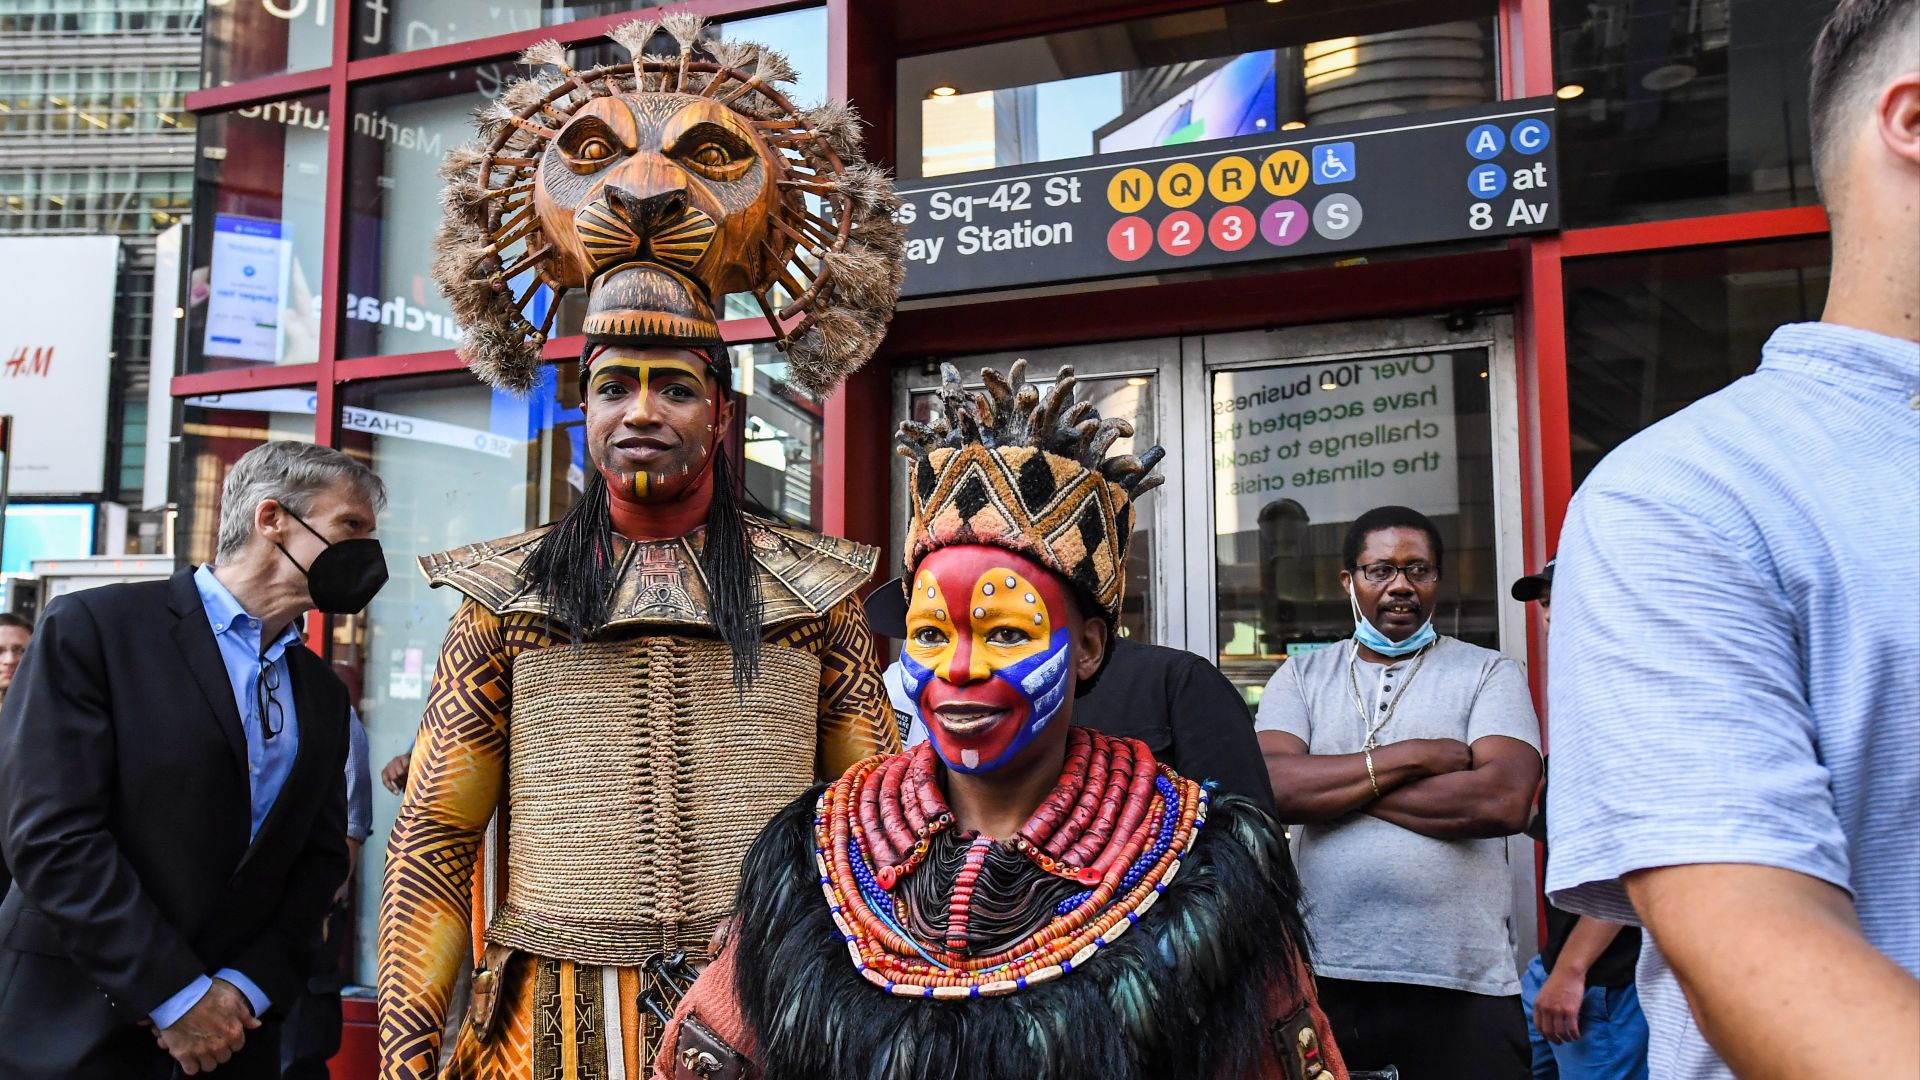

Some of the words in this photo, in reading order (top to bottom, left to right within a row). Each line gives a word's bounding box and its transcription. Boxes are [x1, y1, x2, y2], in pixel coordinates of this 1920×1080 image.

[1475, 130, 1497, 153] A
[1519, 126, 1541, 148] C
[1119, 178, 1141, 203] N
[1168, 172, 1193, 197] Q
[1221, 167, 1243, 192] R
[1268, 159, 1301, 186] W
[1478, 170, 1497, 192] E
[1512, 162, 1548, 190] at
[928, 181, 1032, 223] Sq-42
[1044, 176, 1082, 207] St
[1468, 202, 1494, 231] 8
[1506, 198, 1549, 227] Av
[956, 219, 1074, 256] Station
[1121, 226, 1136, 251] 1
[1170, 220, 1192, 246] 2
[1221, 215, 1243, 241] 3
[1274, 211, 1296, 237] 7
[1325, 203, 1349, 230] S
